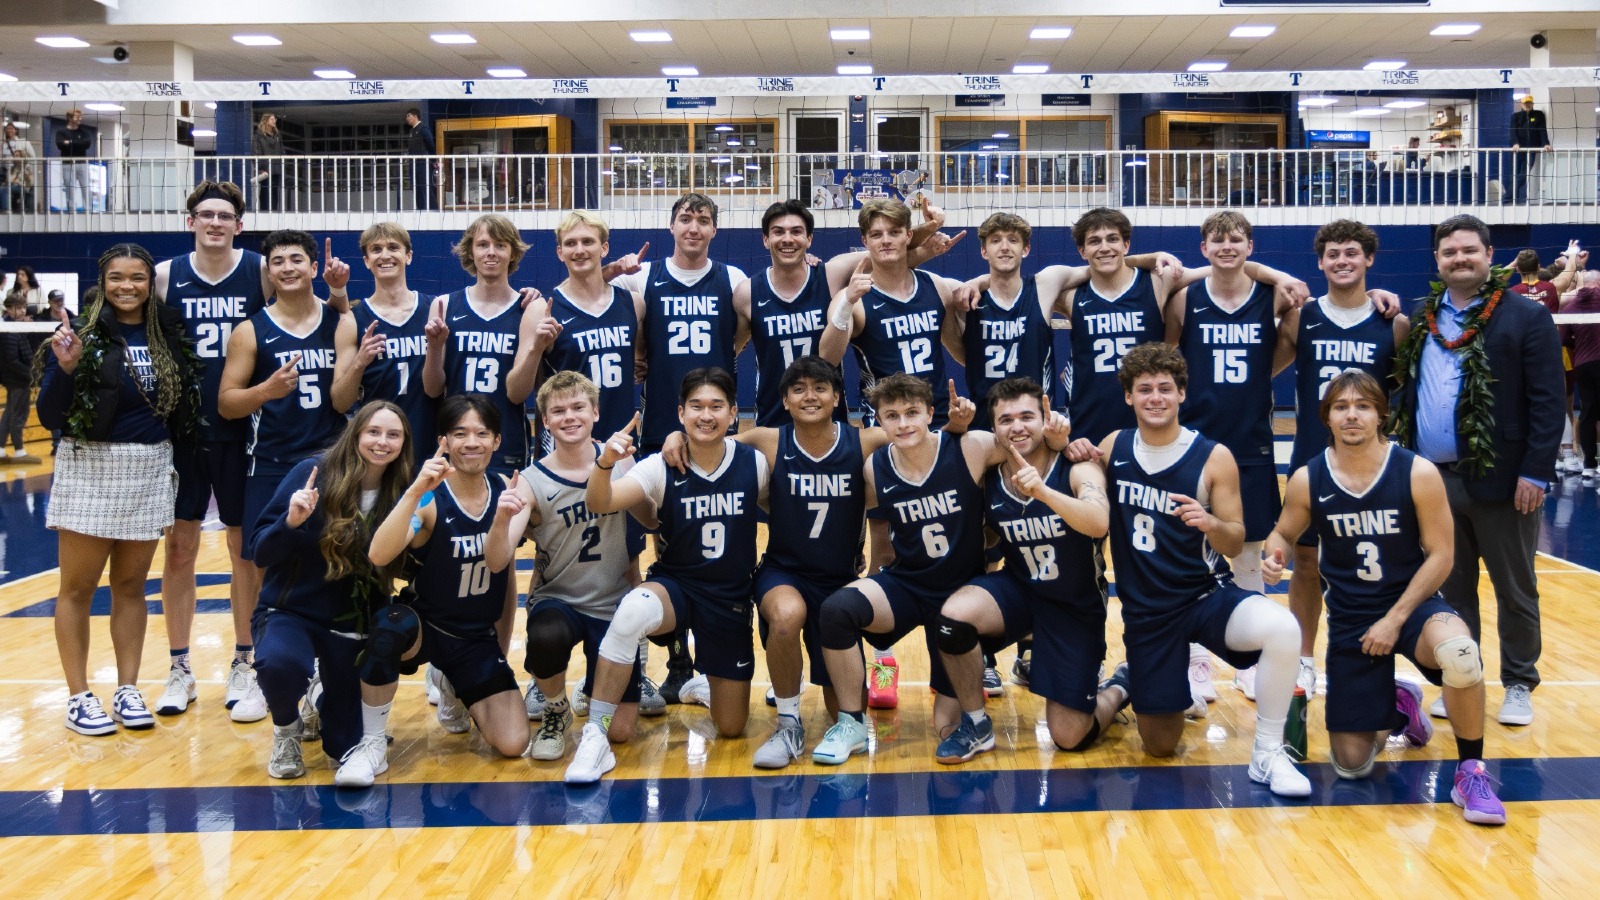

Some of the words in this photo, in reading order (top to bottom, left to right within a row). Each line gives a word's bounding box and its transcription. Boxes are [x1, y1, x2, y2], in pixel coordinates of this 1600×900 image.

[146, 82, 182, 90] TRINE
[349, 81, 384, 89] TRINE
[462, 81, 474, 94] T
[552, 80, 588, 88] TRINE
[667, 79, 679, 92] T
[873, 77, 886, 91] T
[965, 76, 1000, 84] TRINE
[1081, 75, 1093, 89] T
[1289, 73, 1302, 86] T
[1382, 70, 1418, 78] TRINE
[1500, 70, 1512, 83] T
[58, 82, 69, 96] T
[259, 82, 271, 95] T
[182, 297, 246, 318] TRINE
[660, 296, 718, 316] TRINE
[764, 309, 824, 336] TRINE
[881, 310, 939, 338] TRINE
[980, 316, 1026, 340] TRINE
[1084, 312, 1145, 334] TRINE
[1199, 324, 1262, 344] TRINE
[196, 322, 232, 358] 21
[455, 331, 516, 354] TRINE
[572, 326, 630, 352] TRINE
[668, 320, 712, 354] 26
[274, 349, 335, 370] TRINE
[780, 336, 812, 370] 17
[898, 338, 934, 374] 12
[985, 342, 1018, 378] 24
[1312, 340, 1376, 364] TRINE
[398, 362, 409, 395] 1
[465, 357, 499, 392] 13
[588, 353, 622, 388] 16
[1213, 349, 1248, 384] 15
[299, 374, 322, 409] 5
[788, 473, 852, 496] TRINE
[1116, 480, 1178, 514] TRINE
[681, 492, 744, 519] TRINE
[894, 490, 962, 524] TRINE
[808, 502, 829, 538] 7
[999, 514, 1066, 543] TRINE
[1132, 513, 1156, 552] 8
[1326, 510, 1400, 537] TRINE
[579, 526, 602, 562] 2
[702, 522, 726, 559] 9
[922, 522, 950, 558] 6
[1020, 544, 1060, 581] 18
[1356, 542, 1383, 582] 3
[458, 560, 490, 598] 10
